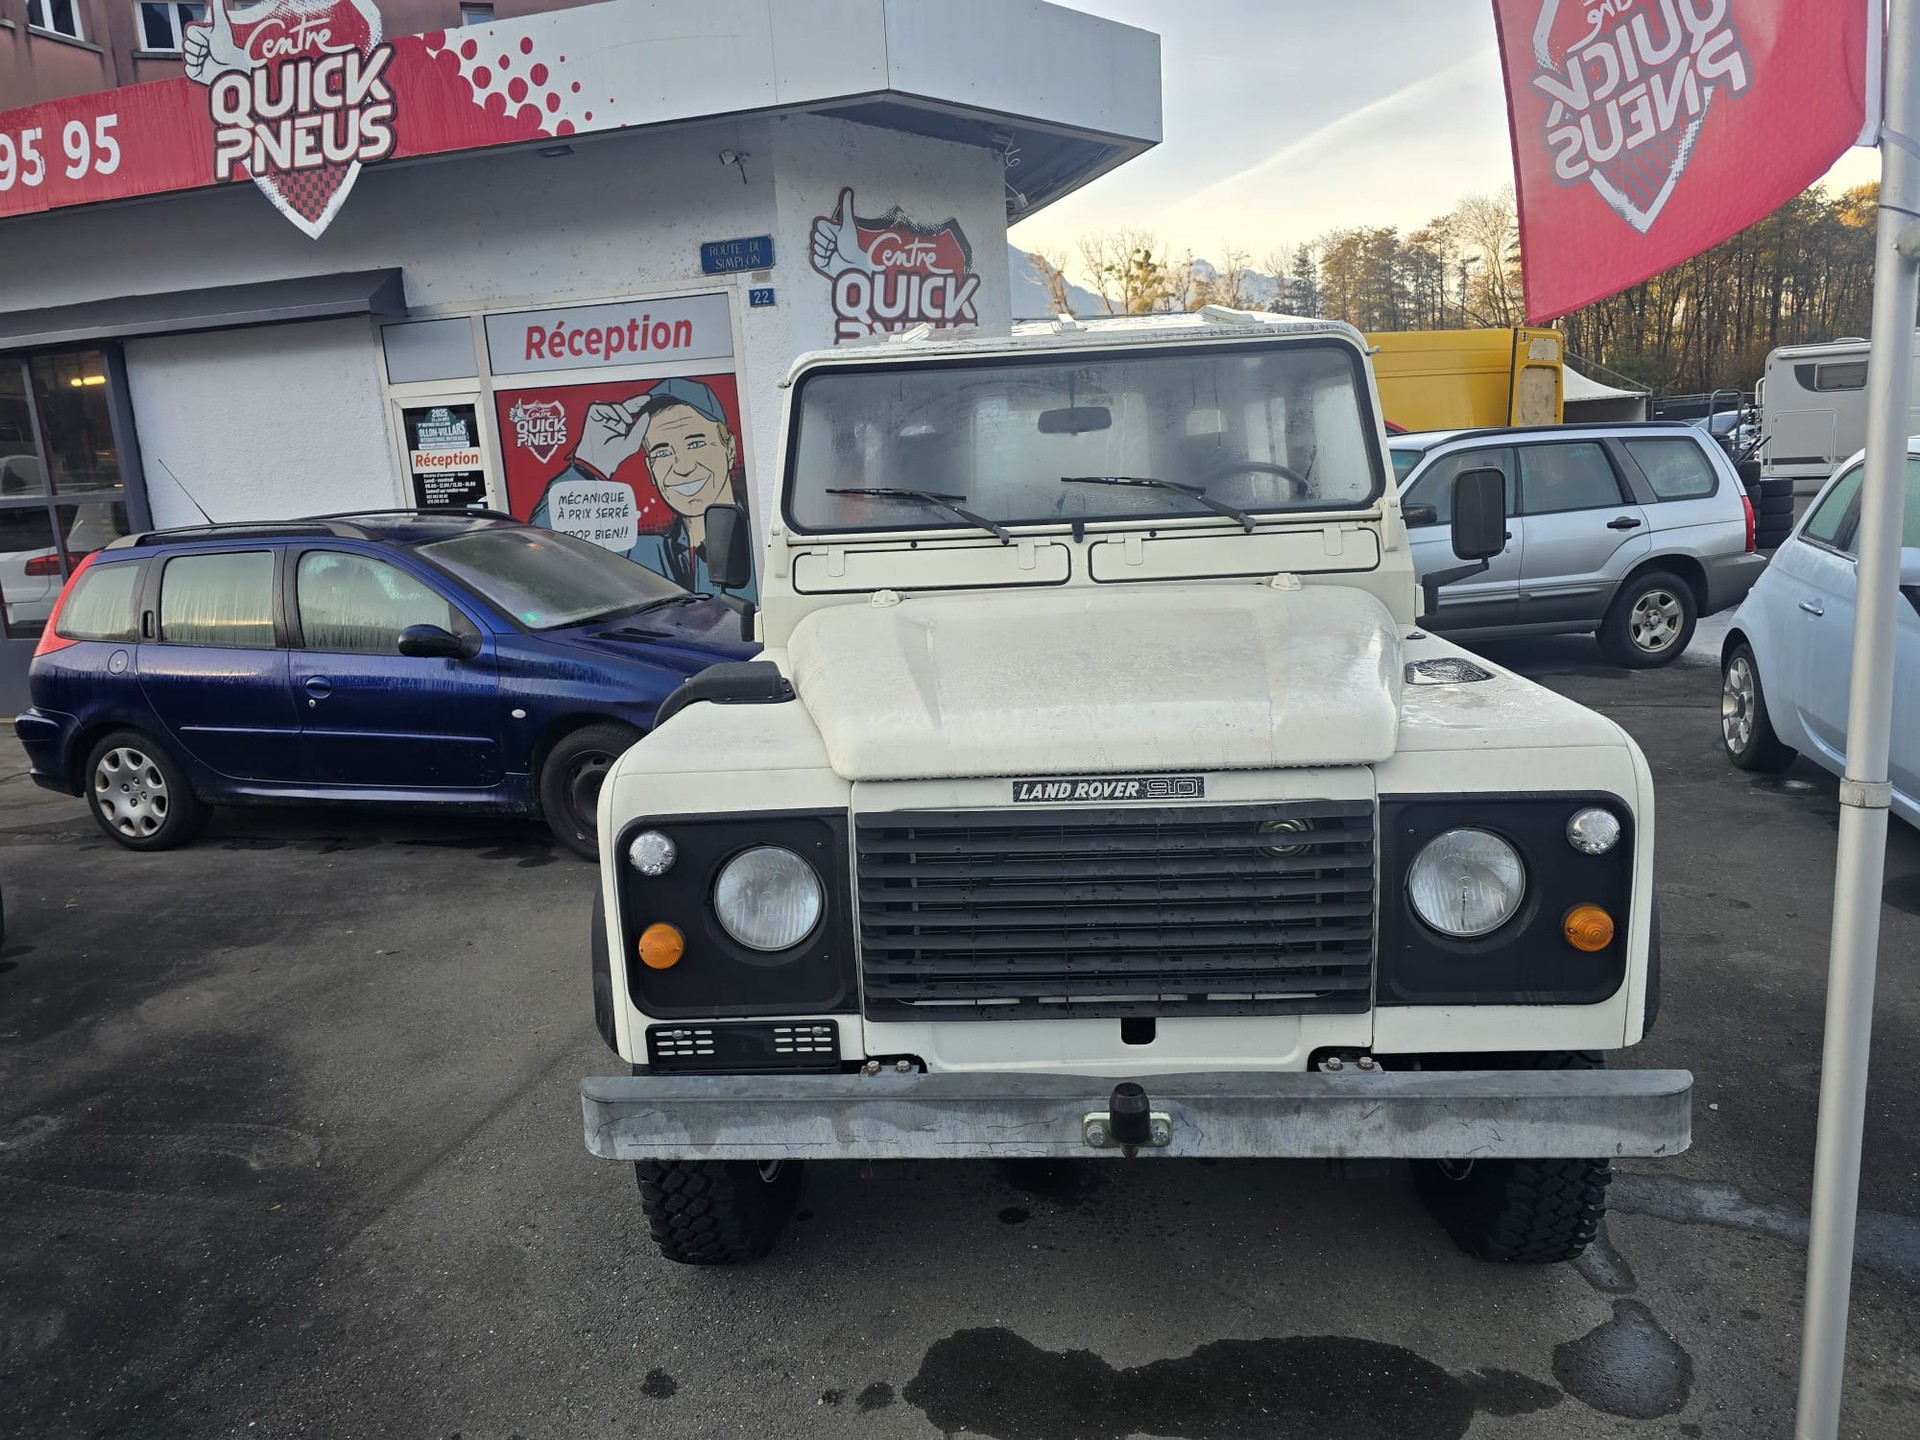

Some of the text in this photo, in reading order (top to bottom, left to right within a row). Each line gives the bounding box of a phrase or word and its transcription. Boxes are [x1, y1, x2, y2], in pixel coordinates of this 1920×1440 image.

[244, 15, 355, 67] Centre
[212, 47, 391, 128] QUICK
[217, 104, 391, 178] PNEUS
[0, 113, 120, 191] 95 95
[709, 240, 764, 257] ROUTE DU
[867, 233, 954, 274] Centre
[715, 254, 761, 270] SIMPLON
[754, 290, 770, 304] 22
[836, 273, 979, 324] QUICK
[525, 314, 693, 361] Réception
[431, 408, 448, 418] 2025
[526, 408, 557, 420] Centre
[418, 420, 466, 437] OLLON-VILLARS
[516, 417, 567, 434] QUICK
[517, 431, 567, 447] PNEUS
[415, 451, 479, 469] Réception
[558, 491, 625, 505] MÉCANIQUE
[557, 504, 629, 520] À PRIX SERRÉ
[594, 526, 629, 540] BIEN!!
[1018, 778, 1200, 800] LAND ROVER 90
